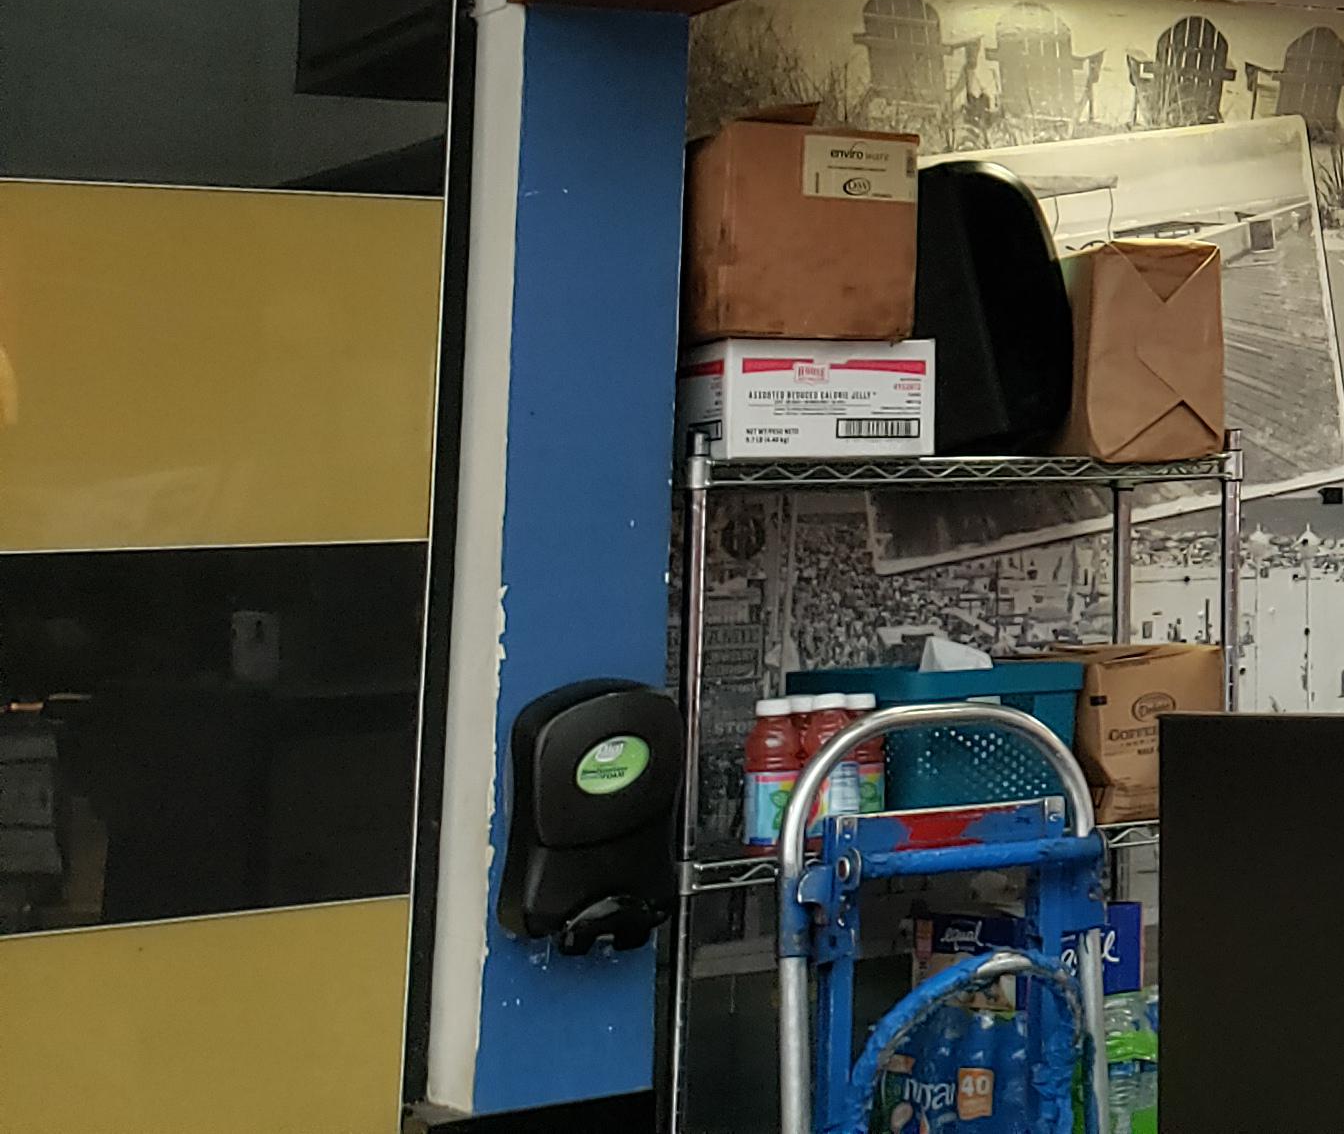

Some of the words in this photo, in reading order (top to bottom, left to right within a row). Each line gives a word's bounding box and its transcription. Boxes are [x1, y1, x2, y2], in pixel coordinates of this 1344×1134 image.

[748, 390, 785, 400] ASSORTED
[786, 390, 819, 400] REDUCED
[820, 390, 849, 400] CALORIE
[939, 919, 985, 952] equal
[961, 1075, 990, 1101] 40
